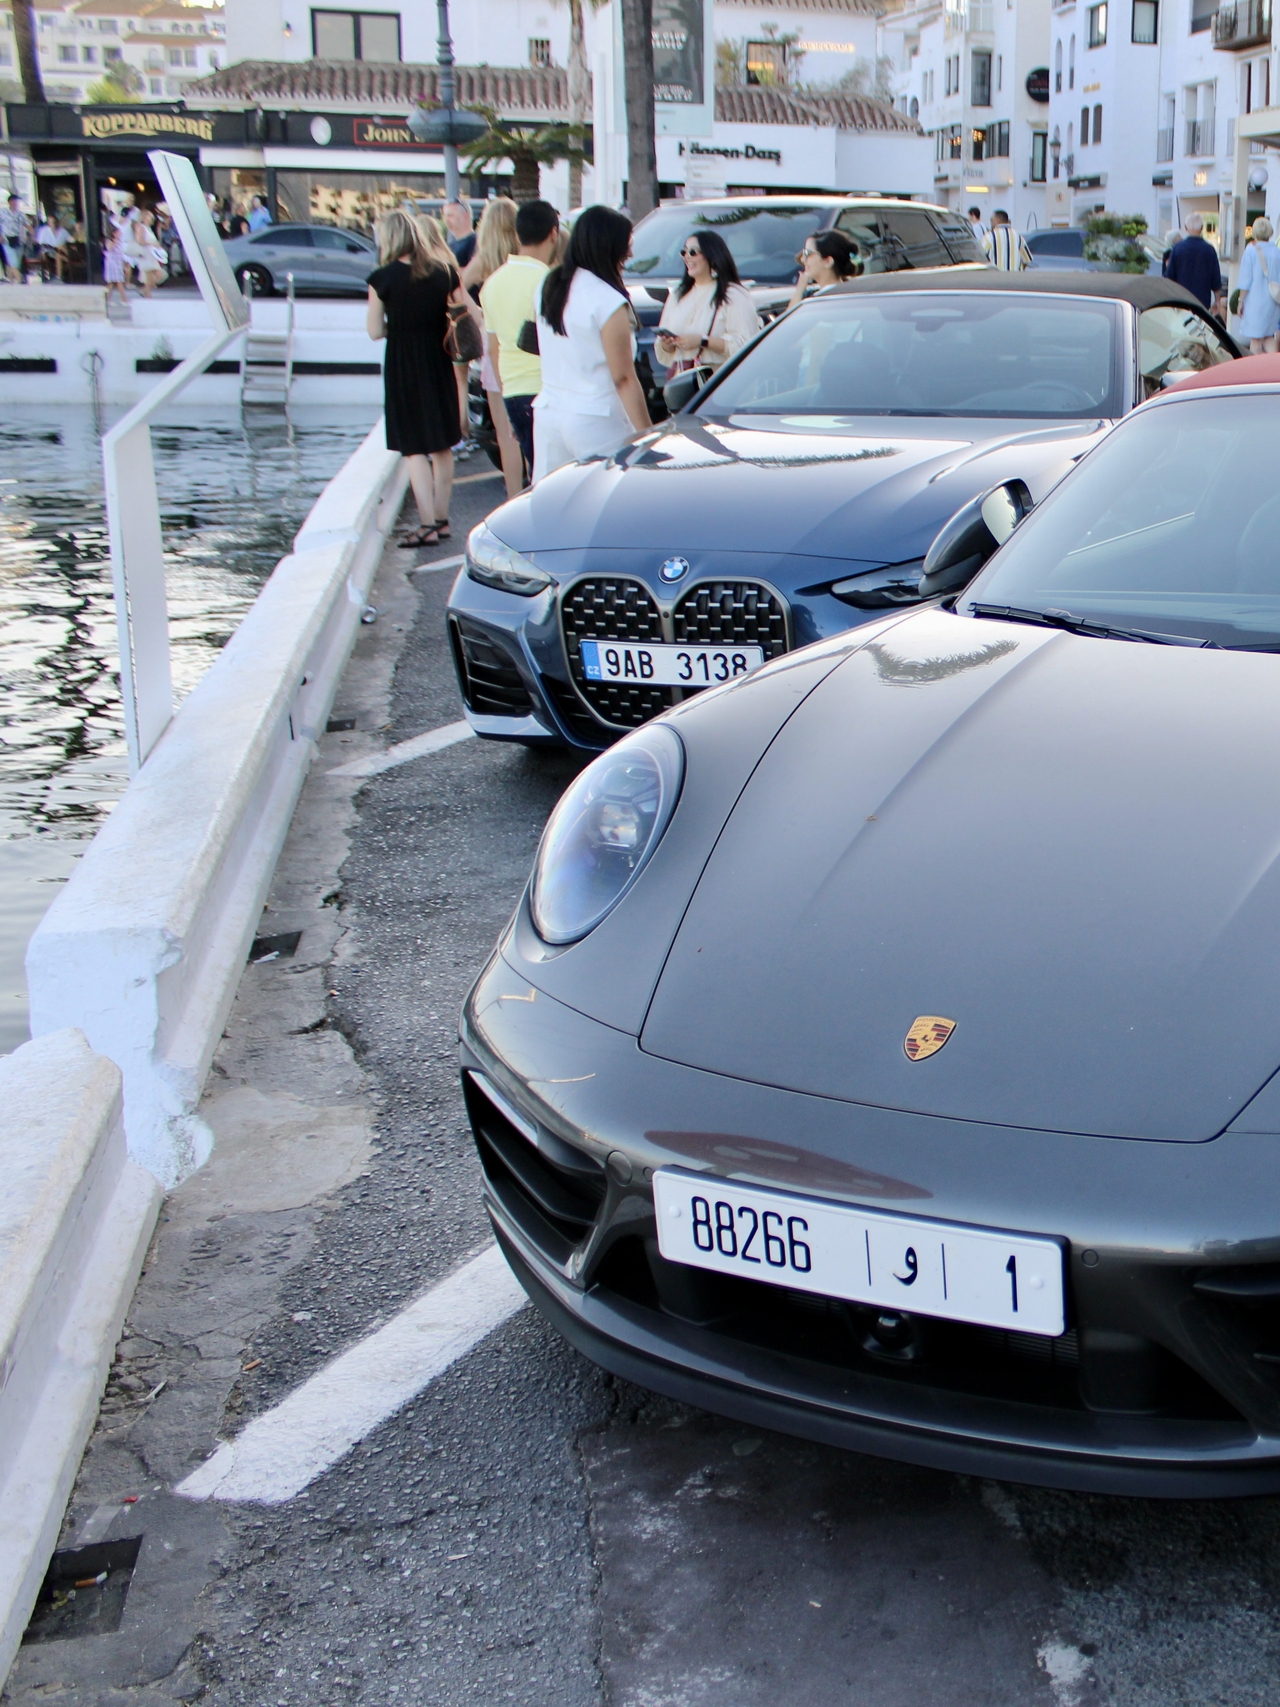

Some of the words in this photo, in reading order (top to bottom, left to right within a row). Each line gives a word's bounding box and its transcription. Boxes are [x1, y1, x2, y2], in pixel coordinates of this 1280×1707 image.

[81, 112, 214, 141] KOPPARBERG
[587, 665, 600, 675] CZ
[605, 649, 654, 679] 9AB
[676, 652, 748, 681] 3138
[691, 1196, 812, 1273] 88266
